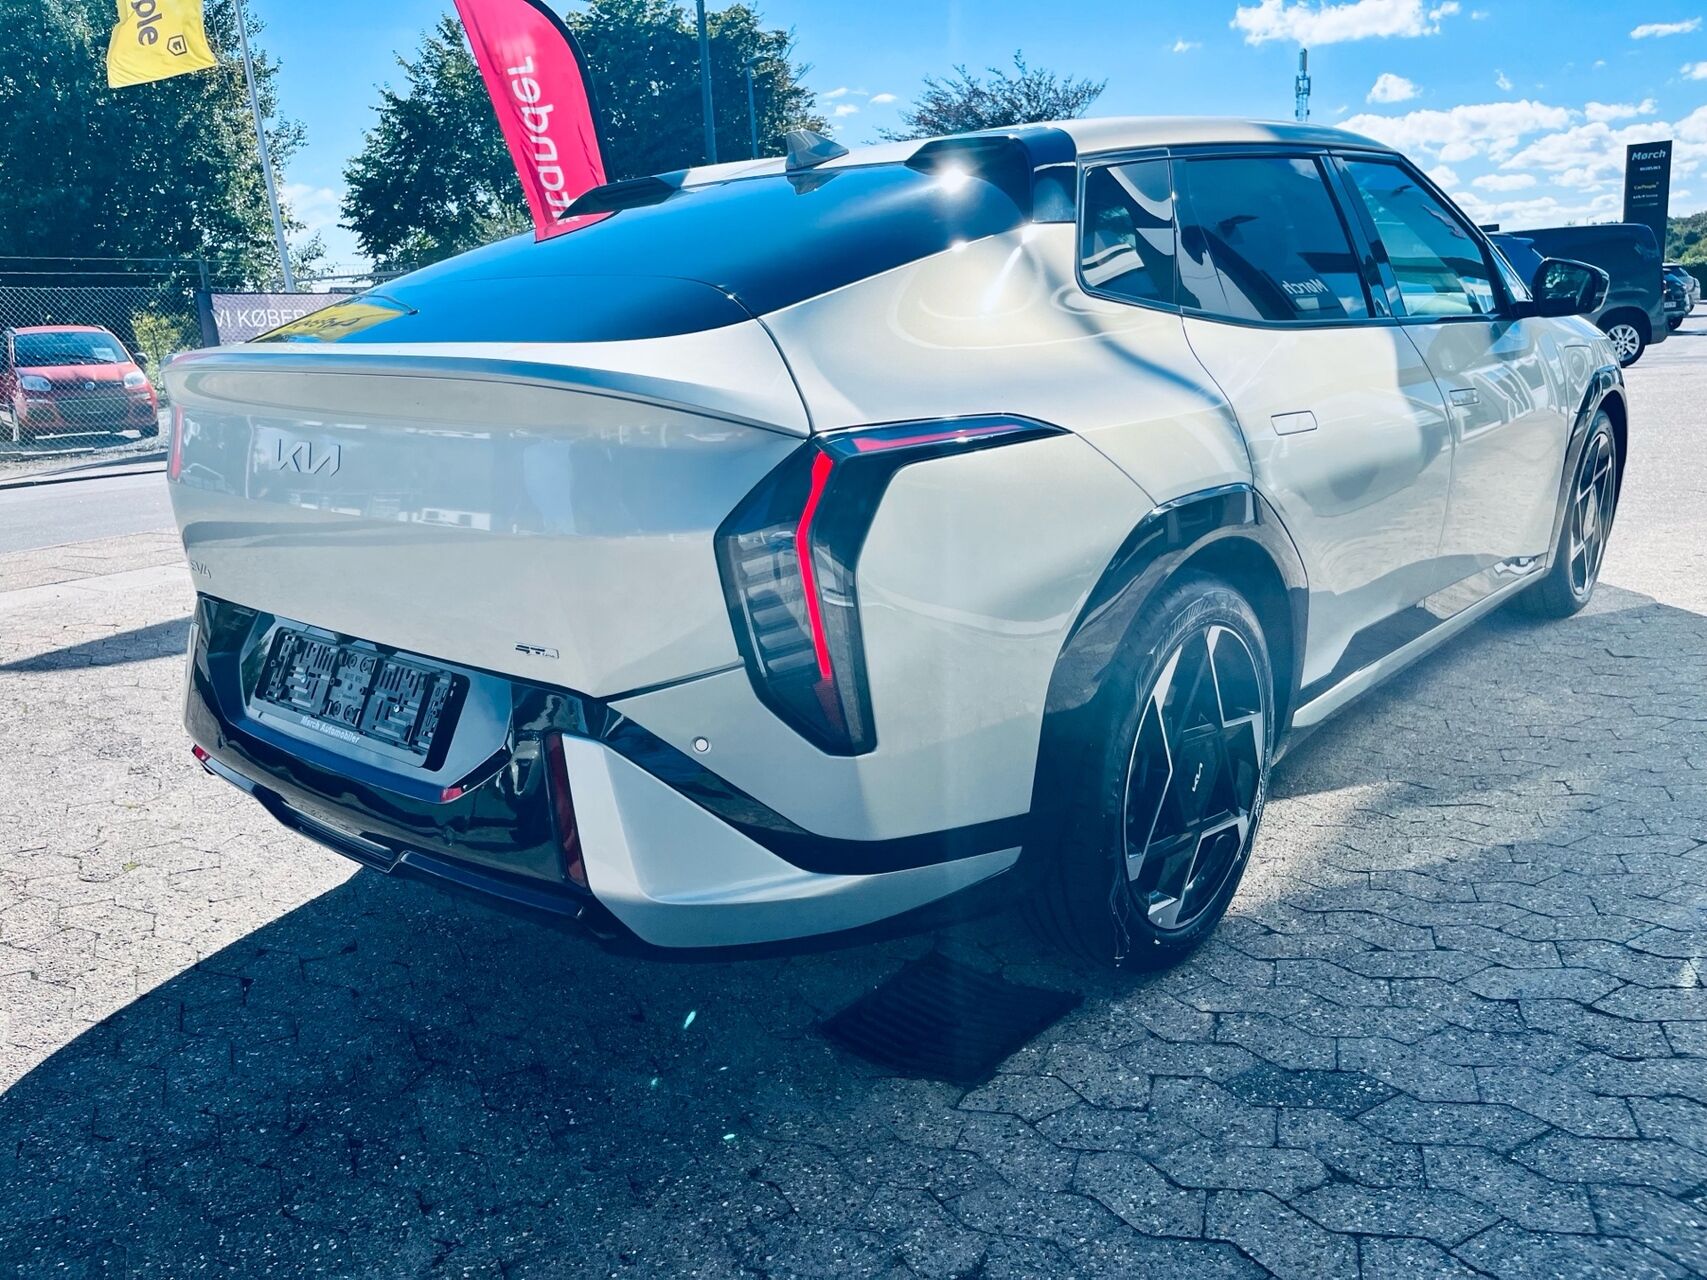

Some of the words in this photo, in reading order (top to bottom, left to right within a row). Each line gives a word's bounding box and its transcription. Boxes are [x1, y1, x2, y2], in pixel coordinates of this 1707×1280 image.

[1631, 149, 1667, 161] Mørch
[271, 437, 342, 477] KIA
[320, 723, 360, 743] Automobiler
